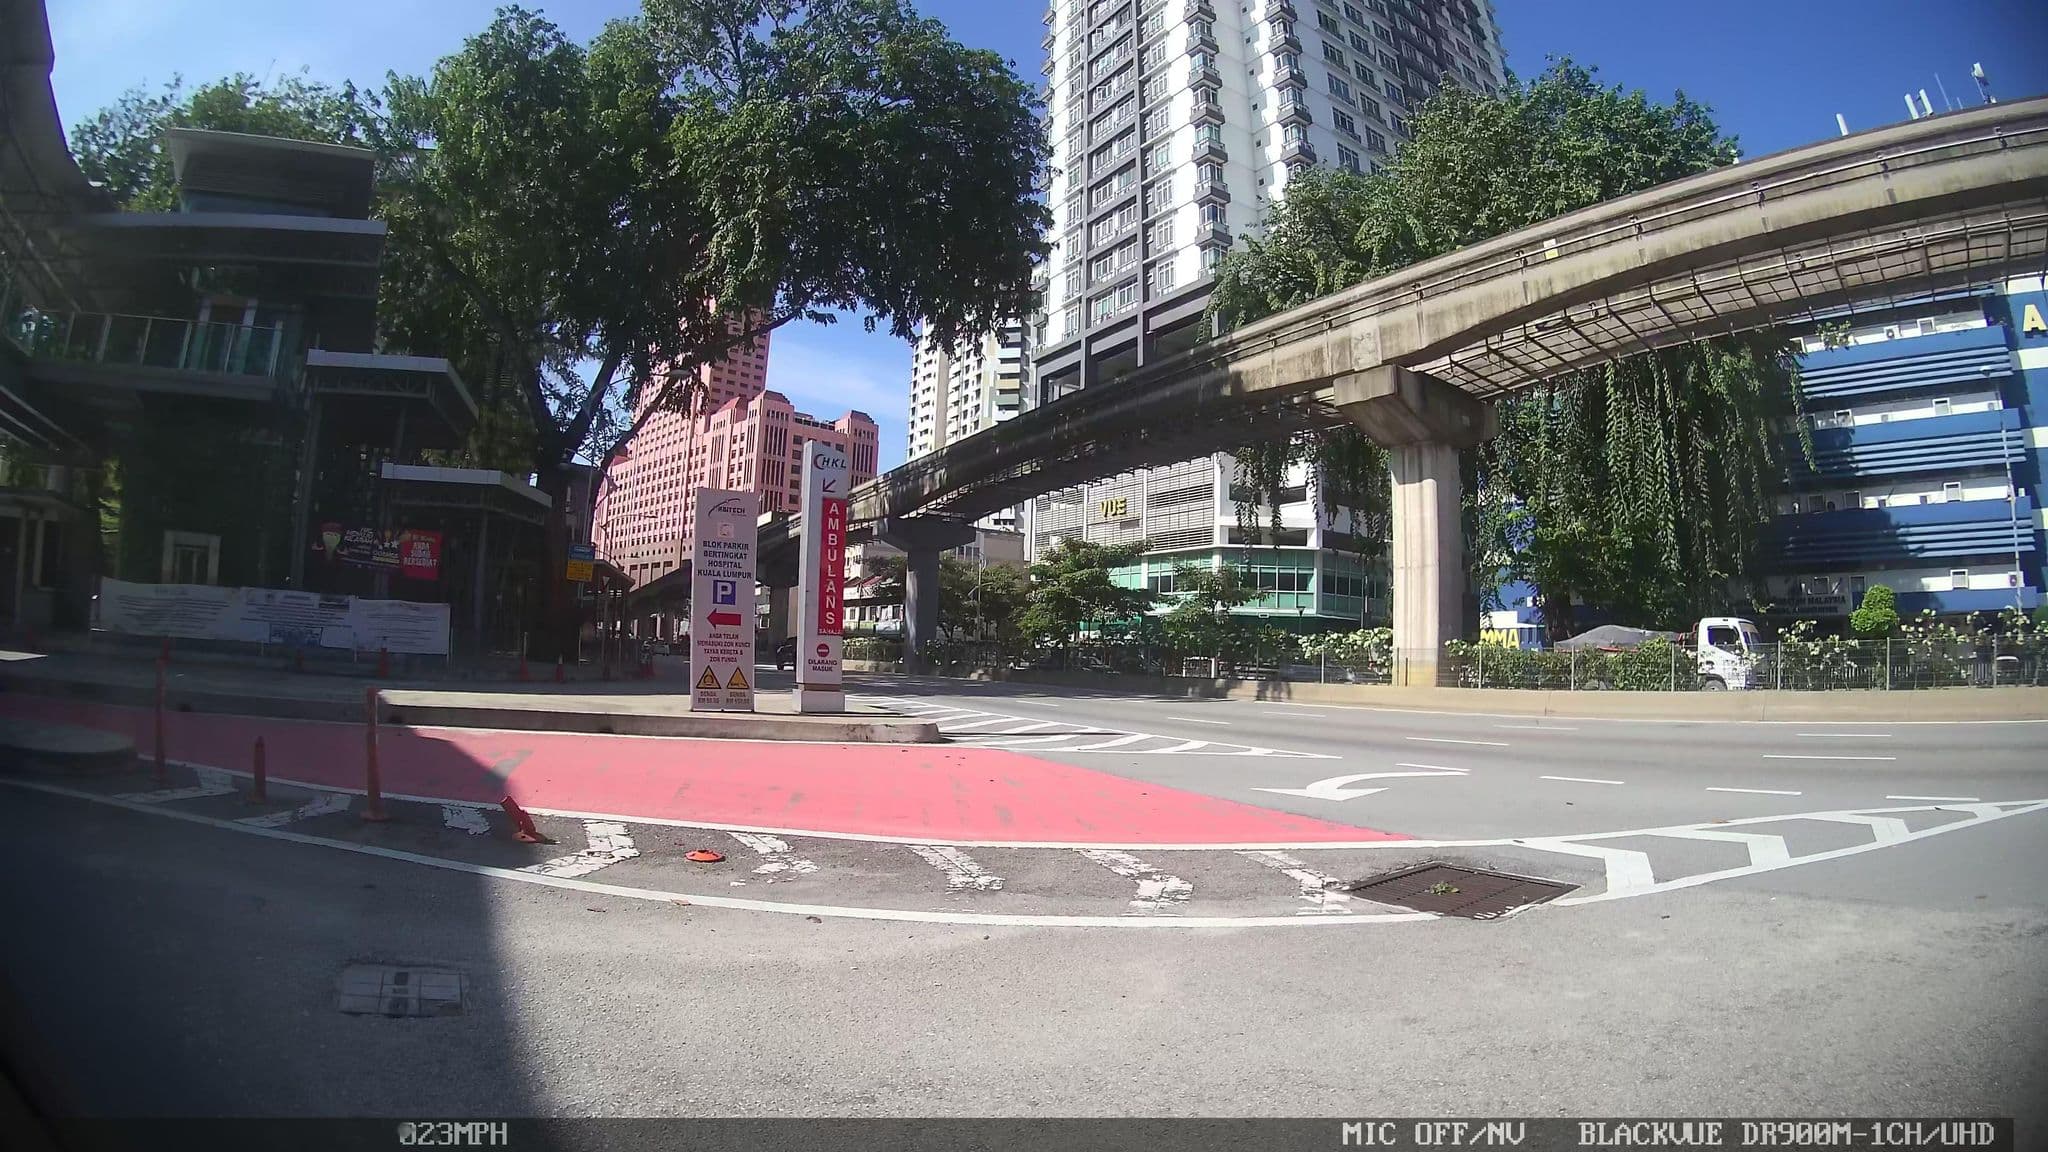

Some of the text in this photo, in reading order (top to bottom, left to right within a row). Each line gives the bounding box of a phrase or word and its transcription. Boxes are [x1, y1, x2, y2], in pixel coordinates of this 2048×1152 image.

[1101, 497, 1127, 517] VUE
[702, 540, 749, 550] BLOK PARKIR
[703, 550, 748, 560] BERTINGKAT
[707, 560, 743, 569] HOSPITAL
[825, 502, 839, 625] AMBULANS
[697, 569, 752, 579] KUALA LUMPUR
[716, 581, 732, 603] P
[1480, 628, 1520, 649] MMA
[808, 658, 838, 666] DILARANG
